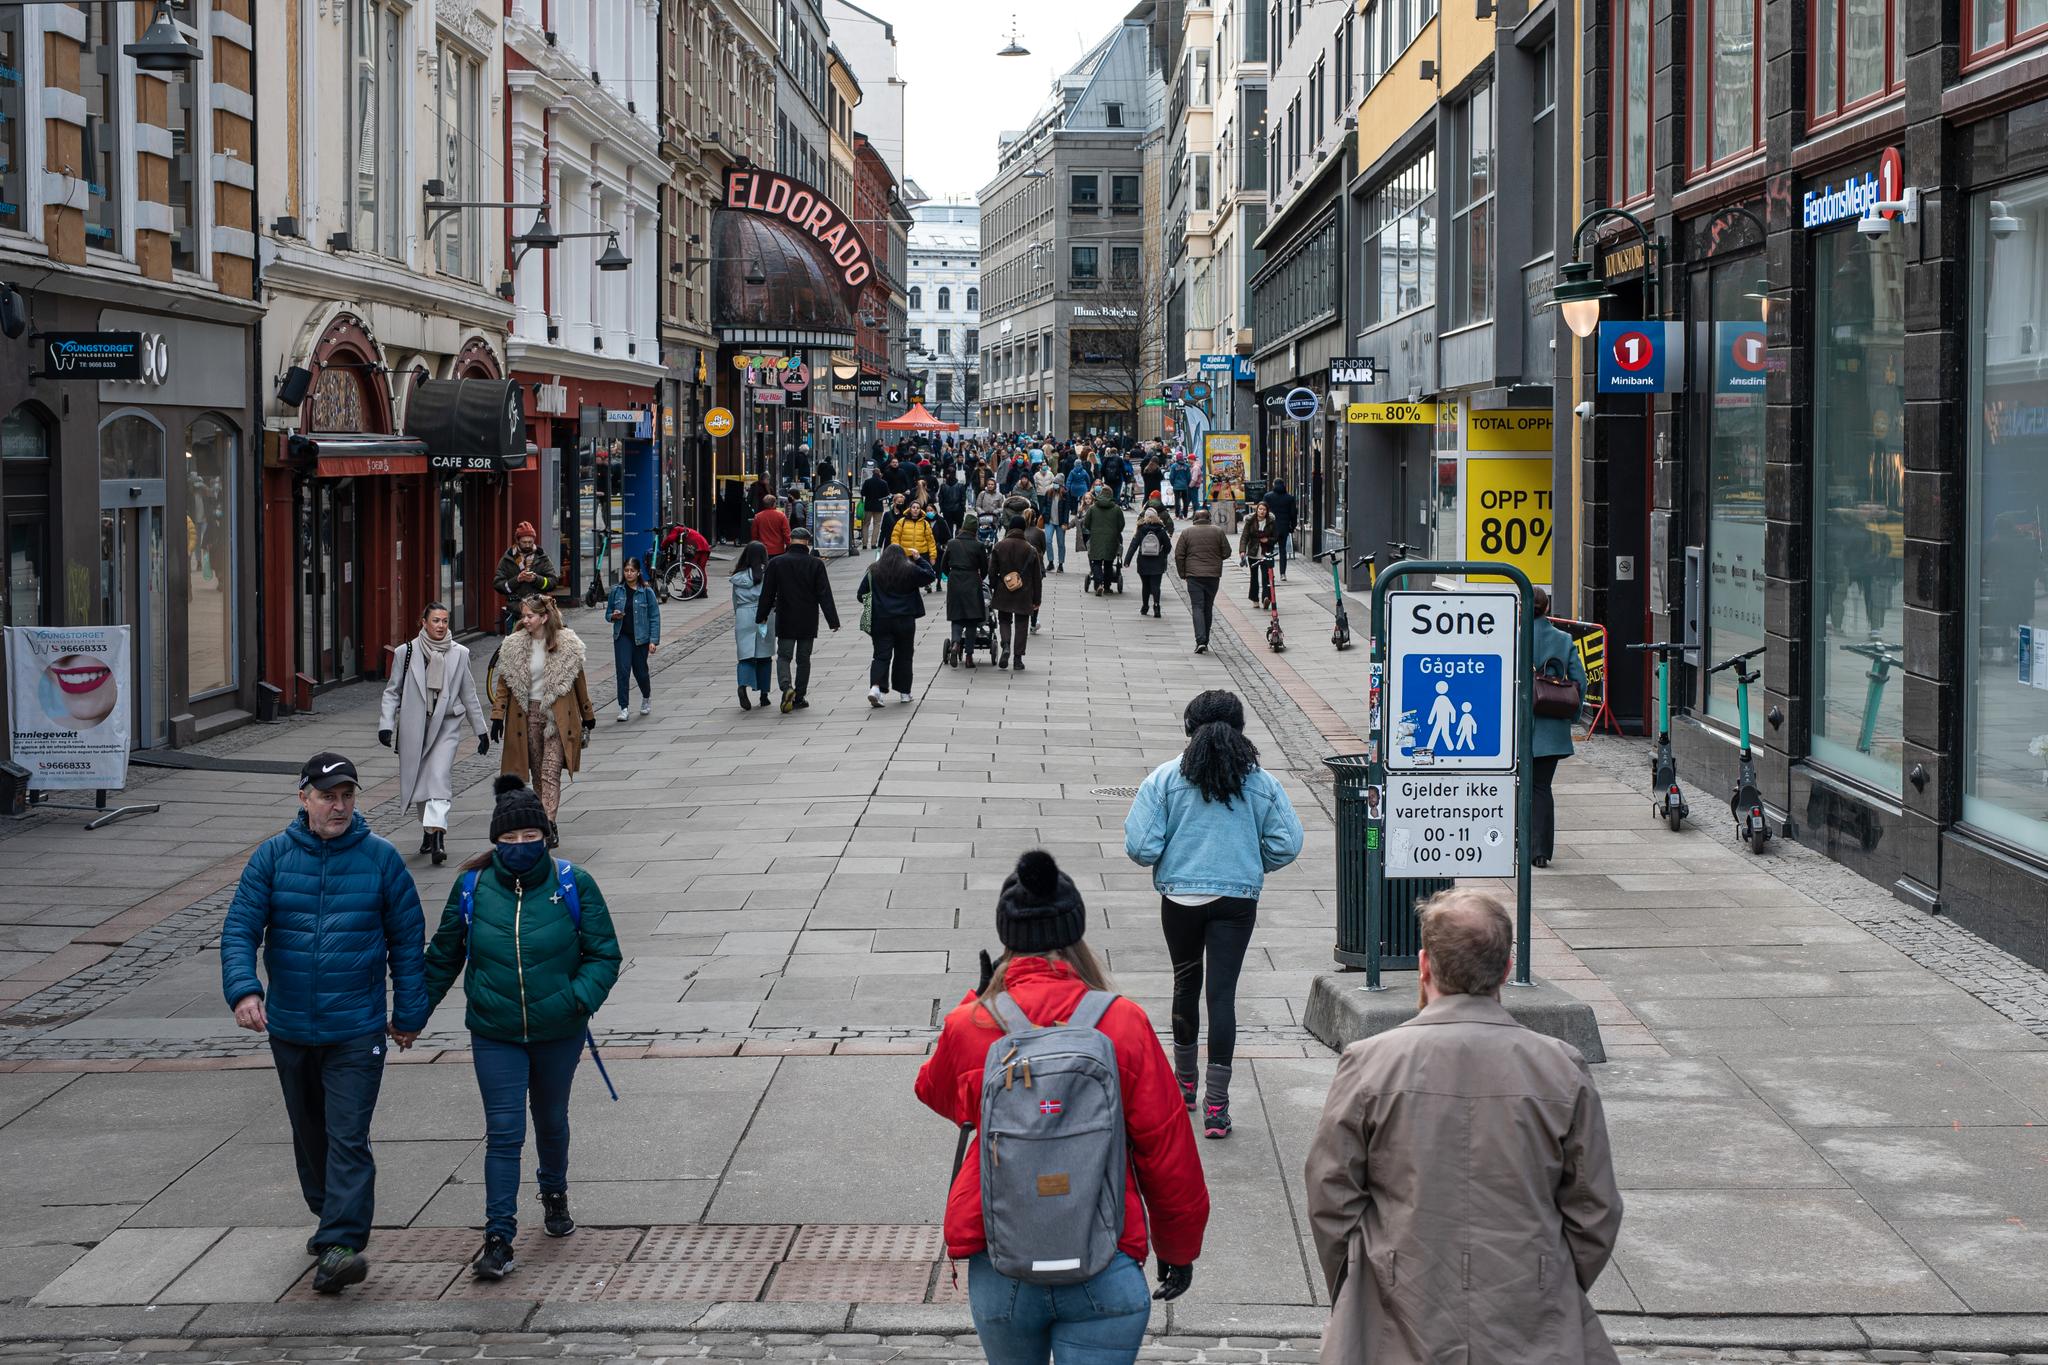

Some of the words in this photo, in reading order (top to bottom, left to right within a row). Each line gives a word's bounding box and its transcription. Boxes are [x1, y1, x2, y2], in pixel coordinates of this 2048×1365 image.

[1804, 172, 1879, 228] EiendomsMegler
[728, 173, 870, 286] ELDORADO
[1605, 240, 1654, 278] YOUNGSTORGT
[56, 341, 134, 353] YOUNGSTORGET
[1332, 359, 1373, 368] HENDRIX
[1332, 369, 1373, 382] HAIR
[1611, 376, 1654, 385] Minibank
[890, 392, 899, 402] K
[1386, 406, 1421, 421] 80%
[1472, 418, 1514, 430] TOTAL
[432, 457, 462, 468] CAFE
[468, 458, 491, 469] SØR
[1481, 490, 1528, 510] OPP
[1411, 604, 1495, 635] Sone
[36, 630, 104, 639] YOUNGSTORGET
[1420, 657, 1485, 678] Gågate
[47, 762, 91, 770] 96668333
[1402, 782, 1459, 800] Gjelder
[1466, 782, 1498, 796] ikke
[1396, 804, 1504, 821] varetransport
[1424, 828, 1445, 842] 00
[1458, 828, 1469, 842] 11
[1414, 846, 1441, 863] (00
[1455, 846, 1482, 863] 09)
